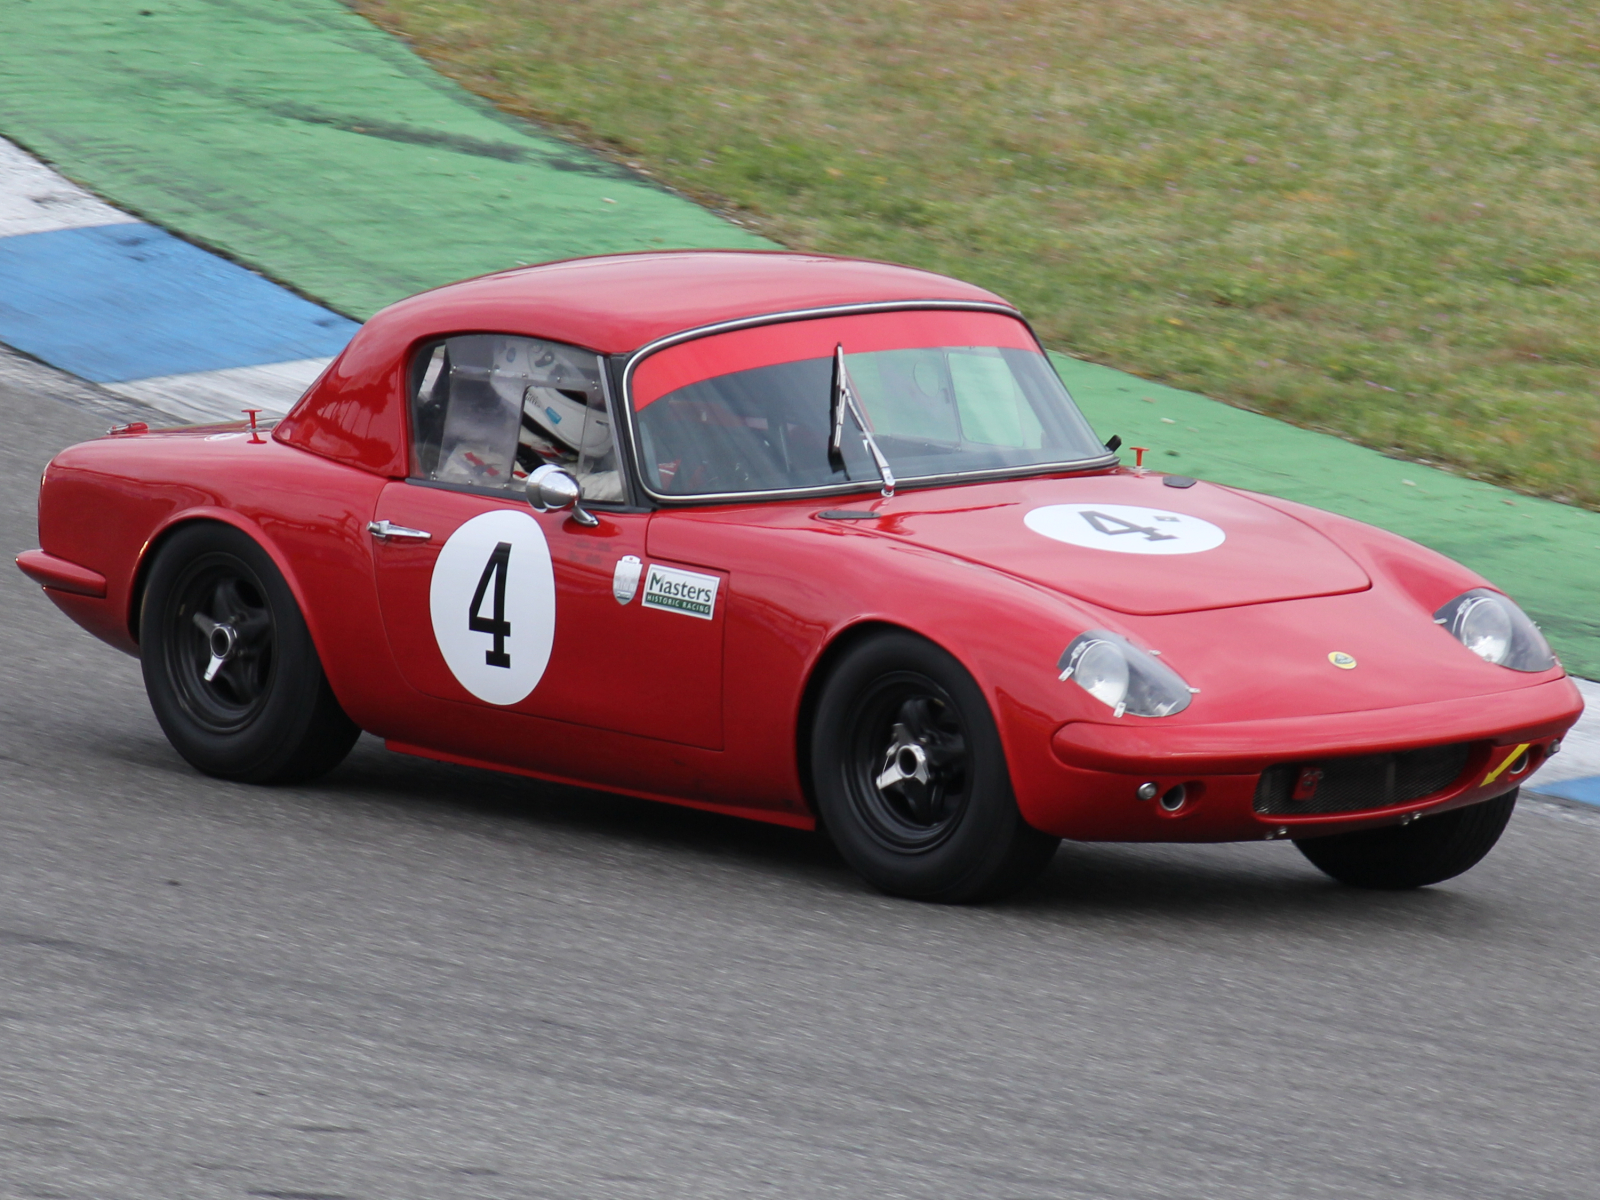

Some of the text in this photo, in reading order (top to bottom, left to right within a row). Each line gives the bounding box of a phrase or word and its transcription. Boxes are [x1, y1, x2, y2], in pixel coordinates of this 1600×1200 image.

[1077, 510, 1180, 542] 4
[648, 572, 712, 602] Masters
[468, 541, 513, 669] 4
[646, 594, 680, 607] HISTORIC
[682, 601, 710, 614] RACING
